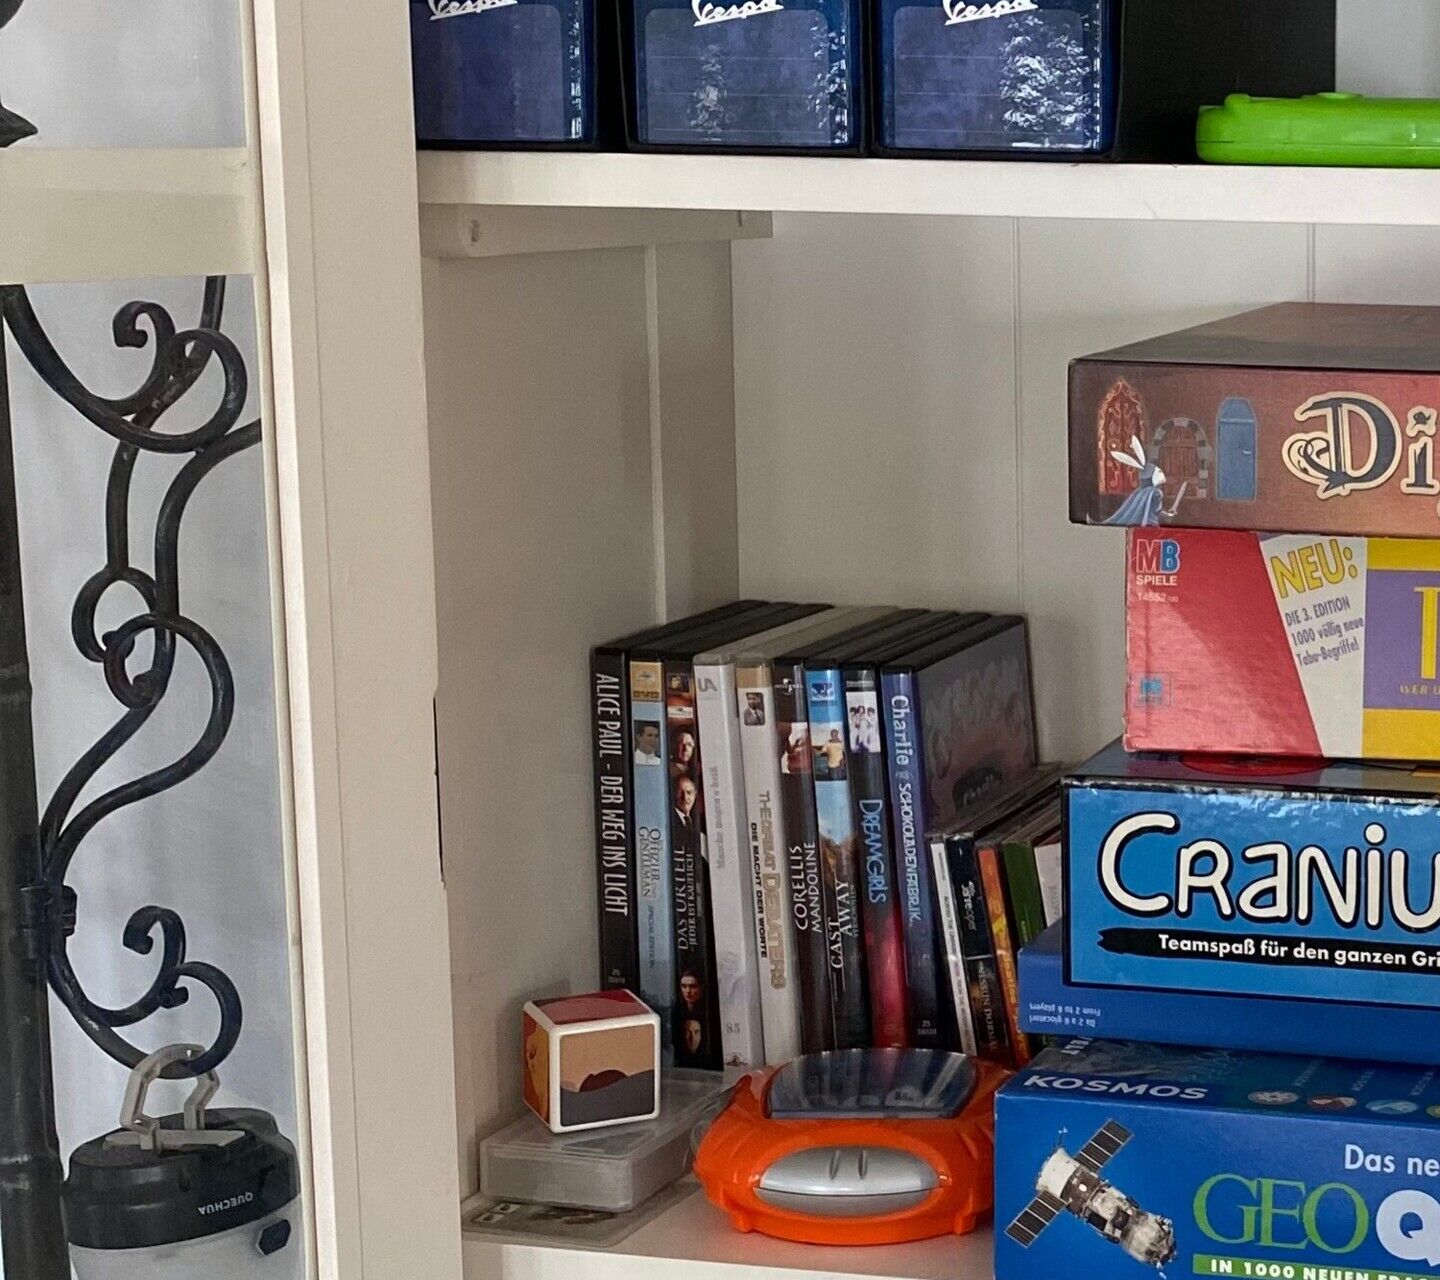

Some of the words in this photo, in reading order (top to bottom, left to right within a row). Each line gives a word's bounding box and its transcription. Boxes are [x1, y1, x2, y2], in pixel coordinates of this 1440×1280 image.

[1136, 538, 1181, 574] MB
[1270, 538, 1358, 599] NEU:
[1291, 628, 1316, 648] 1000
[1317, 621, 1344, 641] völlig
[1343, 617, 1365, 632] neue
[595, 672, 622, 717] ALICE
[598, 720, 624, 759] PAUL
[600, 775, 625, 807] DER
[601, 808, 627, 841] WEG
[602, 844, 627, 870] INS
[603, 871, 629, 918] LICHT
[789, 844, 807, 931] CORELLIS
[803, 841, 823, 934] MANDOLINE
[834, 878, 853, 937] AWAY
[829, 920, 844, 970] CAST
[1158, 934, 1255, 957] Teamspaß
[1258, 940, 1289, 958] für
[1292, 941, 1330, 961] den
[1333, 947, 1408, 968] ganzen
[1022, 1073, 1209, 1100] KOSMOS
[1344, 1142, 1396, 1174] Das
[197, 1191, 254, 1217] QUECHUA
[1192, 1172, 1370, 1255] GEO
[1210, 1258, 1233, 1274] IN
[1242, 1261, 1296, 1280] 1000
